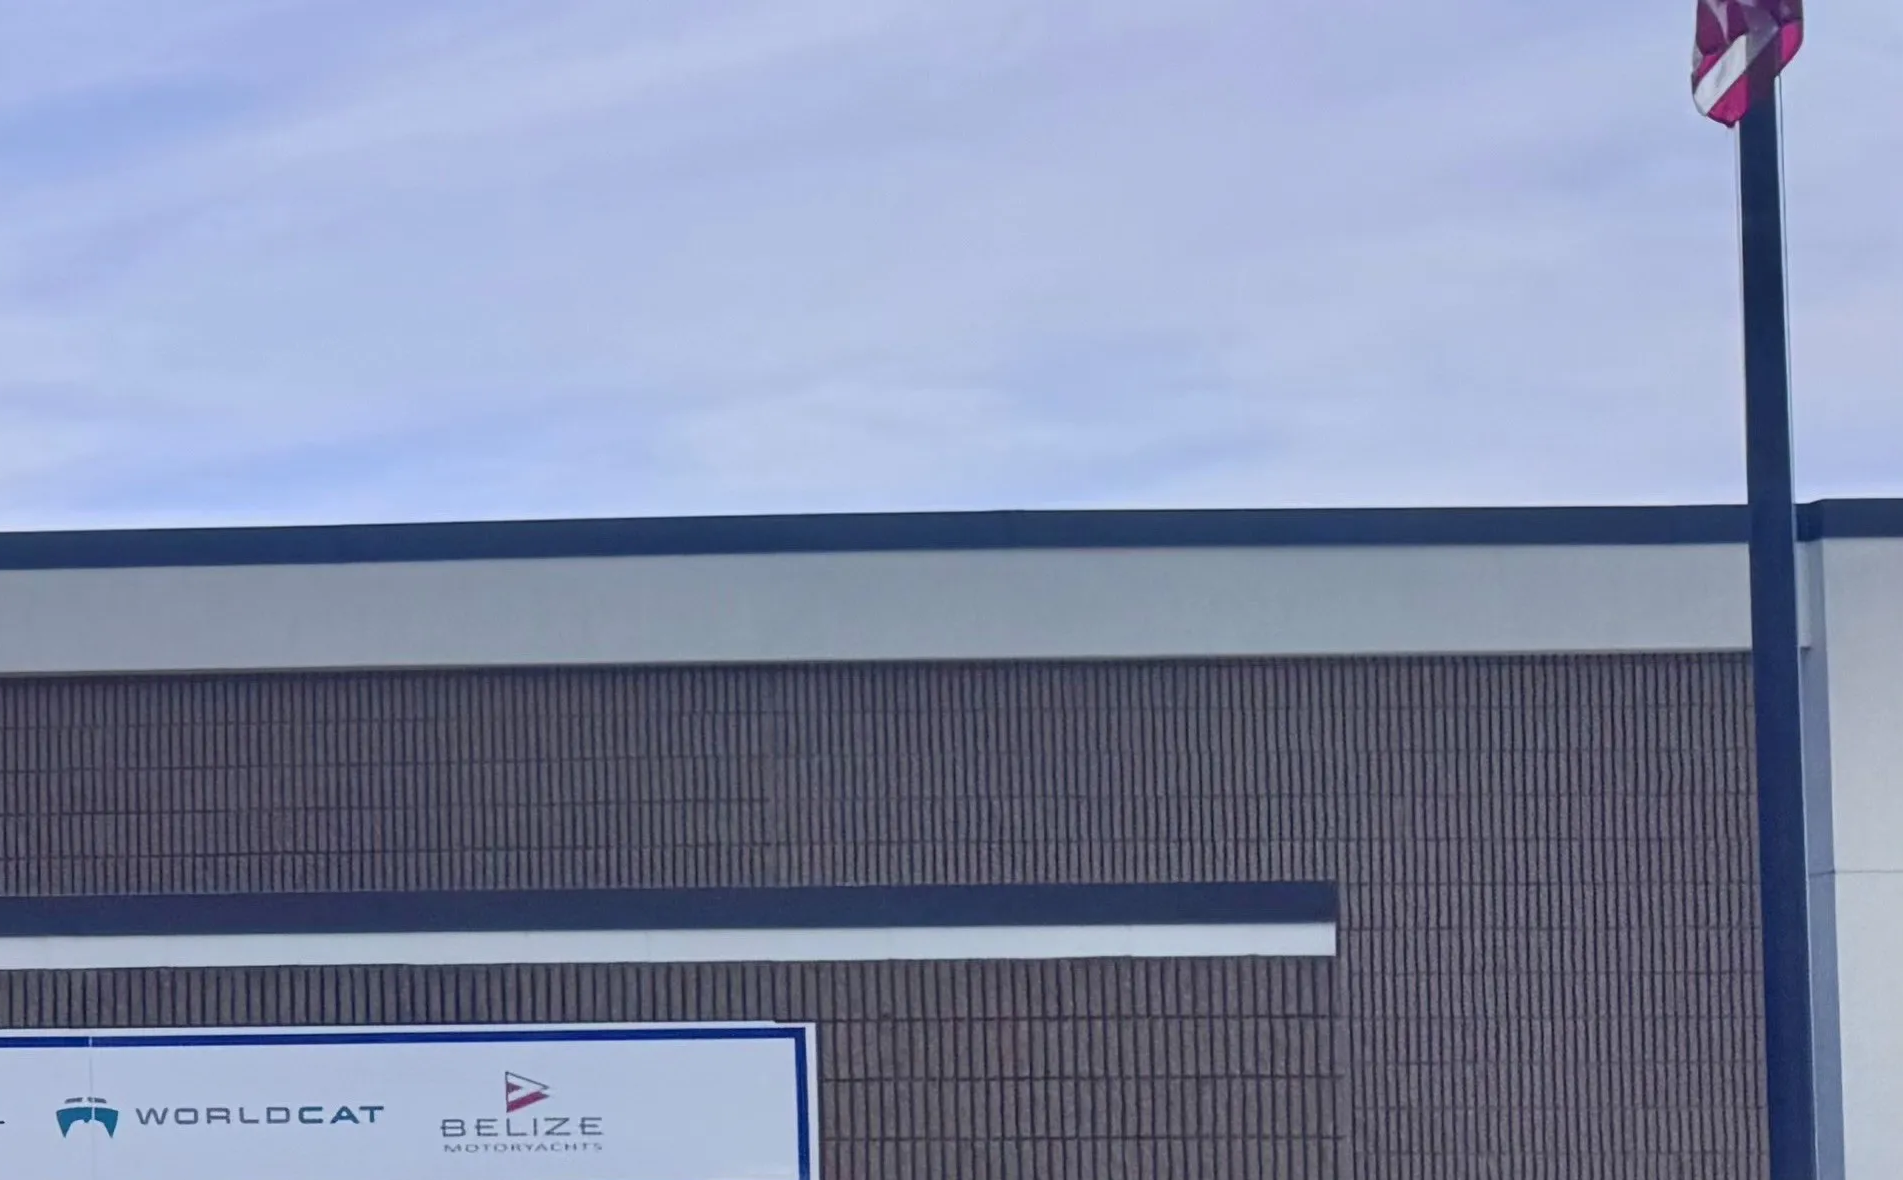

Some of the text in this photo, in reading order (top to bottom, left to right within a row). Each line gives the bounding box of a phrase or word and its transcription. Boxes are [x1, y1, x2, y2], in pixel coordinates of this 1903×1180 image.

[134, 1105, 385, 1127] WORLDCAT
[439, 1117, 605, 1137] BELIZE
[443, 1142, 604, 1153] MOTORYACHTS
